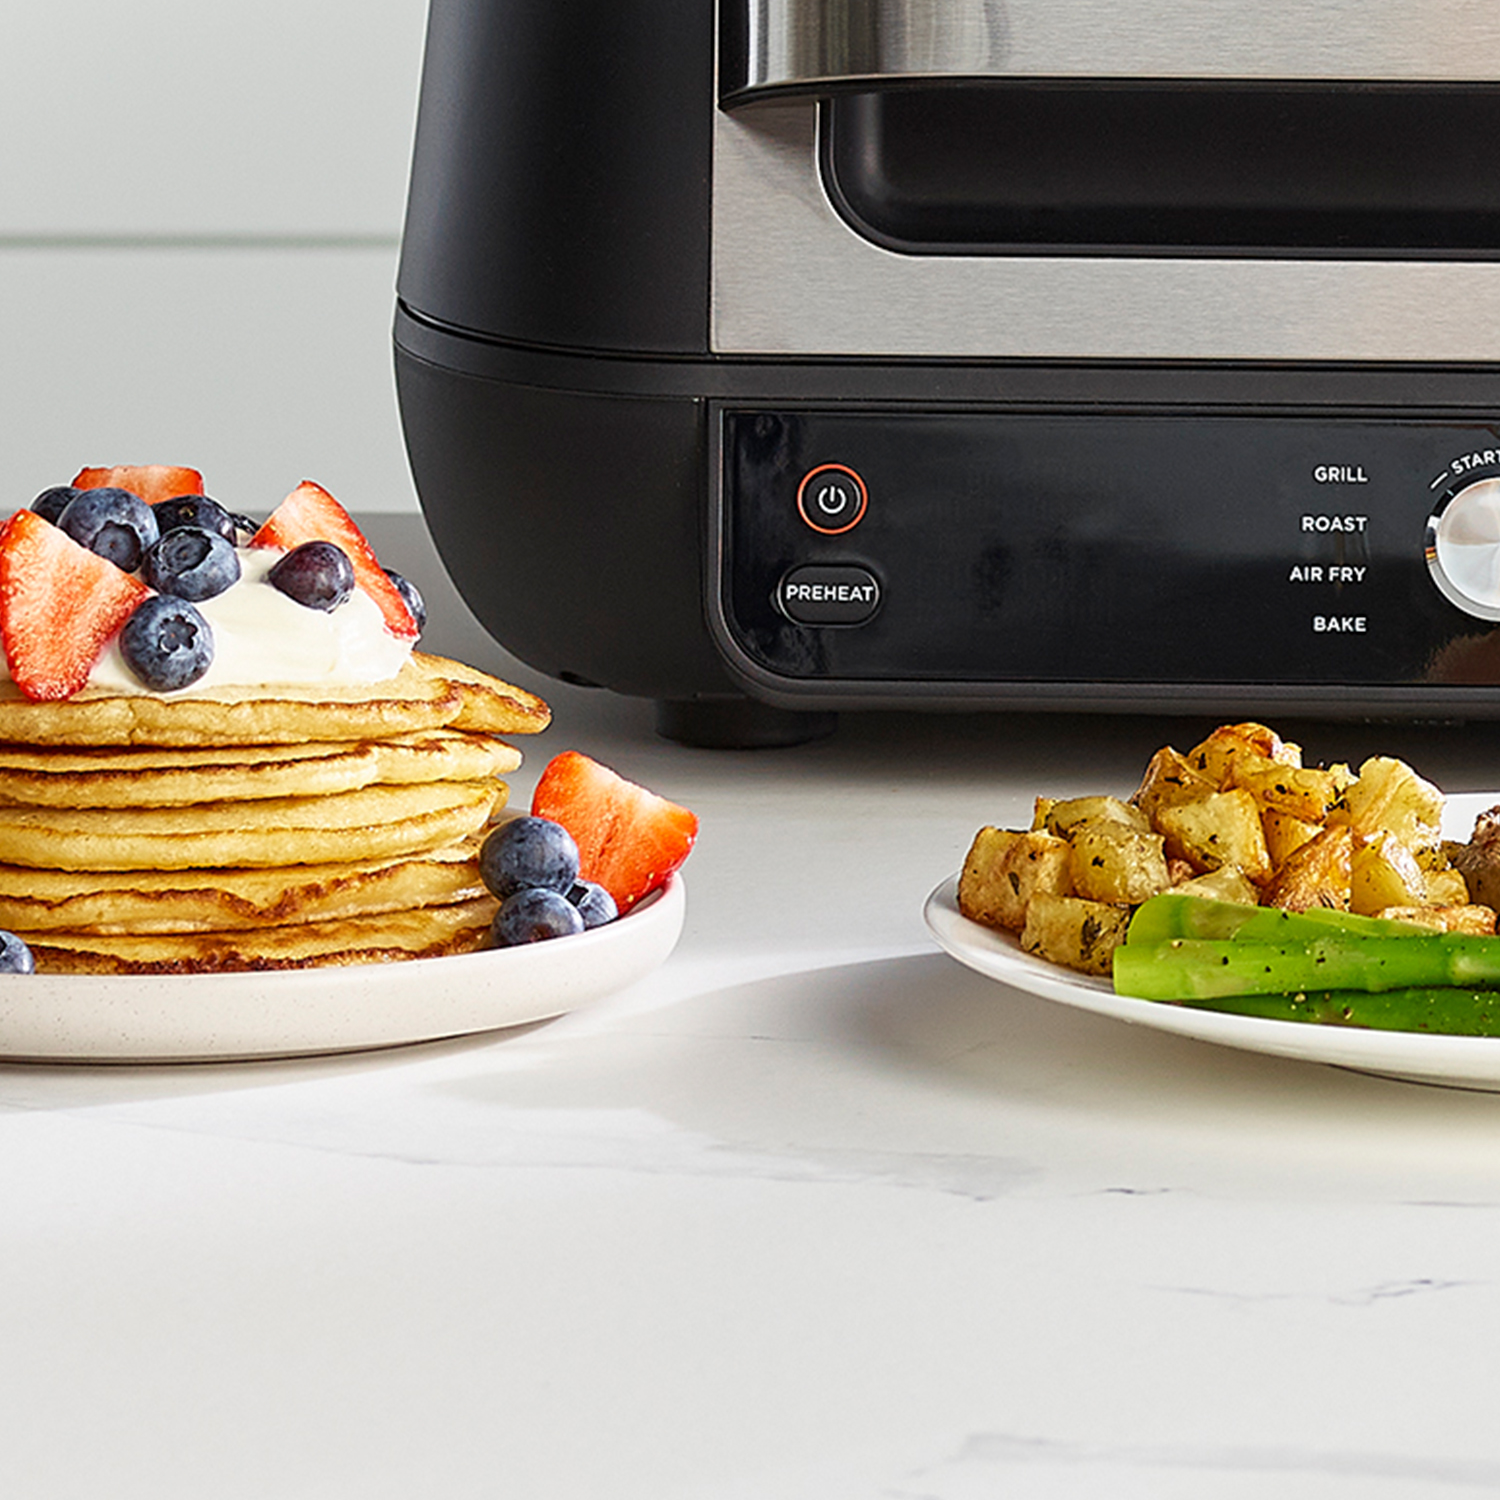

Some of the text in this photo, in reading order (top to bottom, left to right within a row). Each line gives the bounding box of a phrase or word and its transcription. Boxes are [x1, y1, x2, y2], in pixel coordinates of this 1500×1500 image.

[1314, 466, 1368, 483] GRILL
[1301, 516, 1367, 532] ROAST
[1289, 567, 1366, 583] AIR FRY
[785, 585, 874, 601] PREHEAT
[1313, 617, 1367, 632] BAKE
